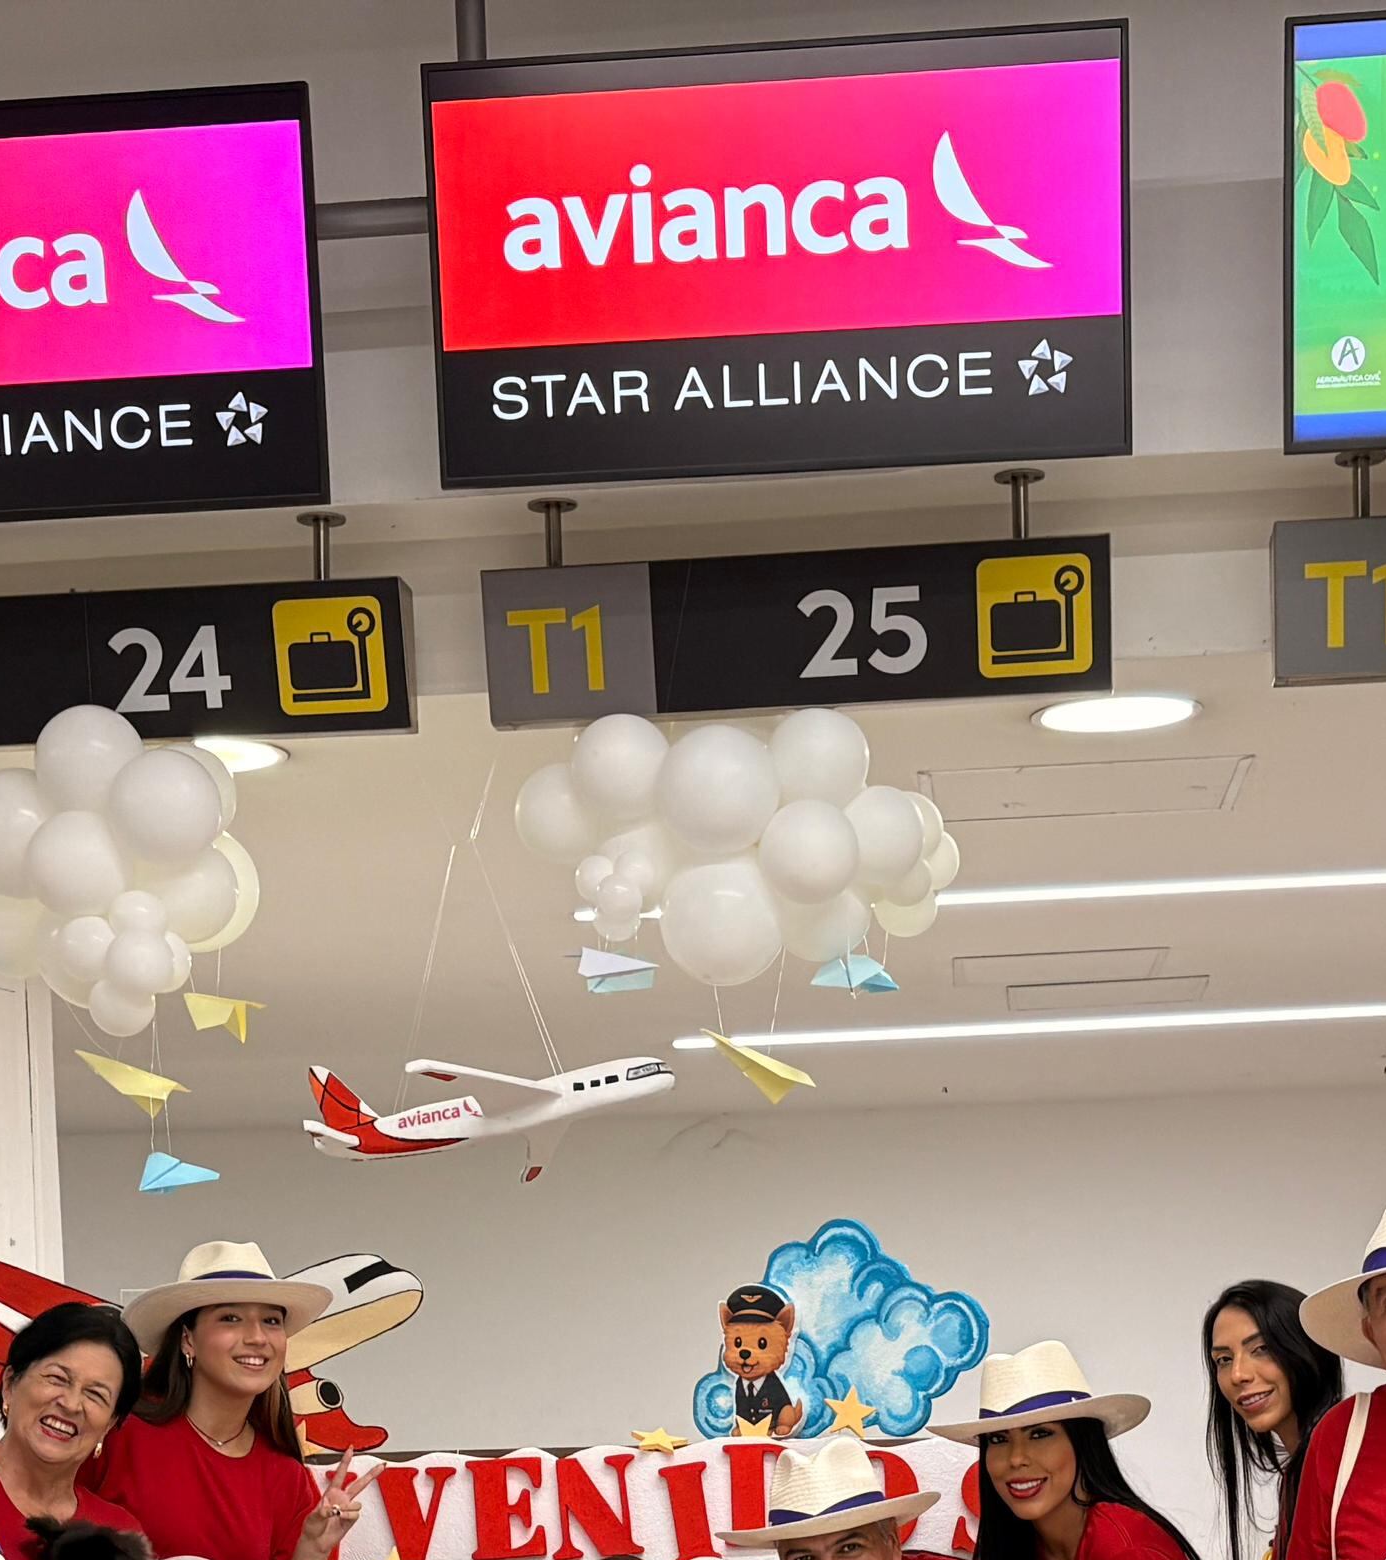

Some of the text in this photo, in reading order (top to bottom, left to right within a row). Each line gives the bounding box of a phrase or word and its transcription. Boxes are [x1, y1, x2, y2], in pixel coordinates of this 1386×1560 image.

[502, 164, 910, 271] avianca
[491, 351, 993, 421] STAR ALLIANCE
[107, 623, 232, 713] 24
[507, 584, 929, 694] T1 25
[398, 1106, 461, 1129] avianca
